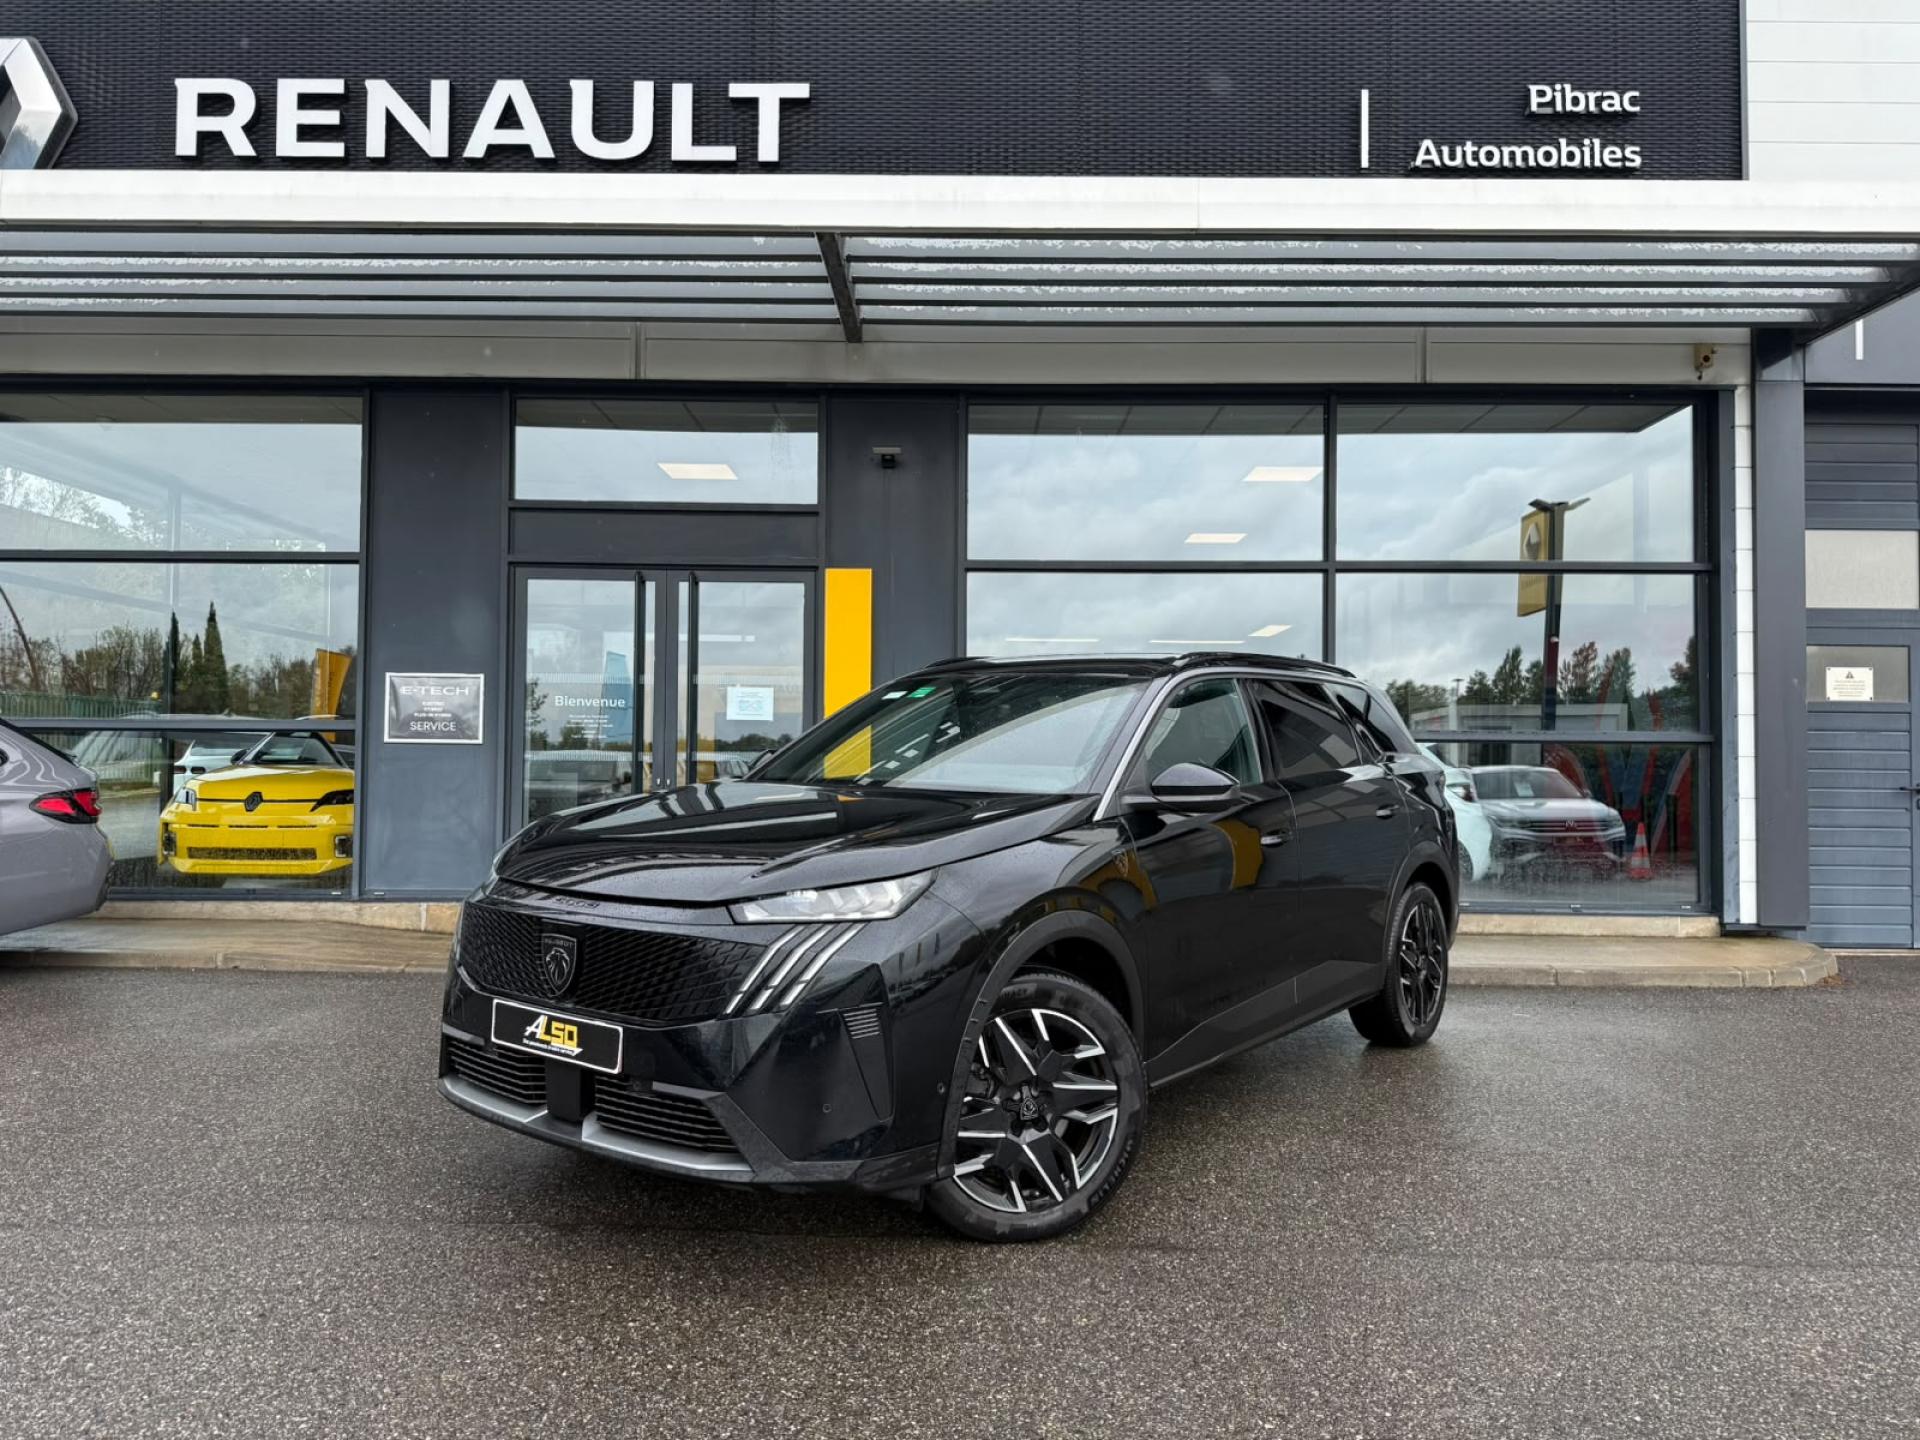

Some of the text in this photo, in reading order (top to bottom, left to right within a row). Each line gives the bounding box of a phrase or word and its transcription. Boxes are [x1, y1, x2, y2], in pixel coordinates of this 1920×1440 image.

[1527, 83, 1641, 113] Pibrac
[174, 77, 811, 163] RENAULT
[1414, 138, 1643, 168] Automobiles
[401, 685, 469, 696] E-TECH
[554, 695, 626, 708] Bienvenue
[409, 721, 457, 732] SERVICE
